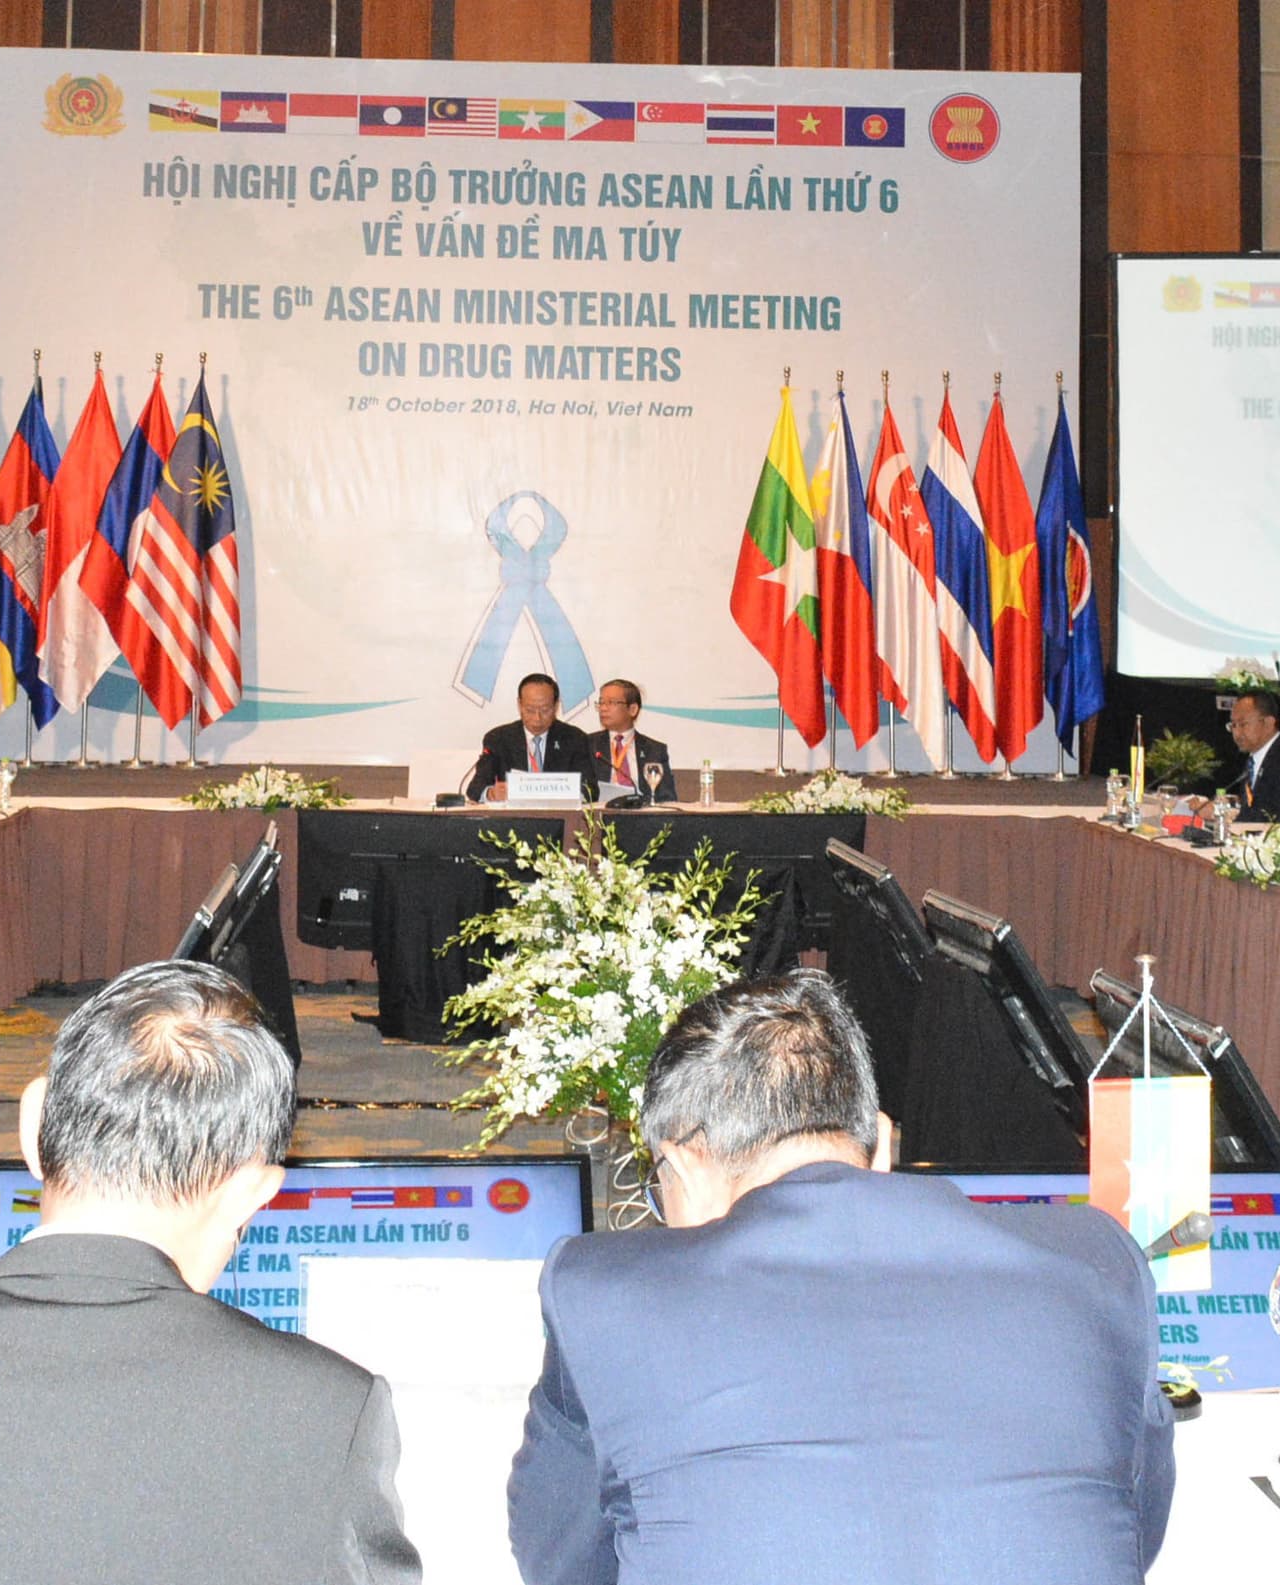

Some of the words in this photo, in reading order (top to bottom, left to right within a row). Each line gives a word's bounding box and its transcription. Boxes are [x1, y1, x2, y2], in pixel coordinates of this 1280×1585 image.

[143, 155, 201, 206] HỘI
[213, 163, 297, 208] NGHỊ
[309, 153, 379, 202] CẤP
[391, 160, 437, 212] BỘ
[448, 158, 587, 207] TRƯỞNG
[598, 172, 714, 210] ASEAN
[725, 163, 792, 212] LẦN
[802, 170, 872, 214] THỨ
[878, 178, 900, 214] 6
[361, 210, 404, 258] VỀ
[415, 210, 485, 259] VẤN
[496, 213, 540, 260] ĐỀ
[552, 225, 608, 262] MA
[618, 219, 683, 264] TÚY
[197, 283, 261, 321] THE
[272, 284, 313, 321] 6th
[324, 286, 442, 324] ASEAN
[453, 287, 677, 329] MINISTERIAL
[688, 293, 842, 332] MEETING
[357, 340, 408, 378] ON
[418, 342, 513, 380] DRUG
[524, 344, 682, 383] MATTERS
[346, 395, 380, 413] 18th
[386, 396, 466, 415] October
[470, 398, 521, 417] 2018,
[527, 399, 557, 415] Ha
[561, 400, 599, 418] Noi,
[606, 401, 643, 417] Viet
[648, 402, 694, 418] Nam
[1242, 397, 1273, 420] THE
[285, 1224, 356, 1244] ASEAN
[410, 1218, 453, 1242] THỨ
[456, 1223, 469, 1242] 6
[257, 1253, 291, 1273] MA
